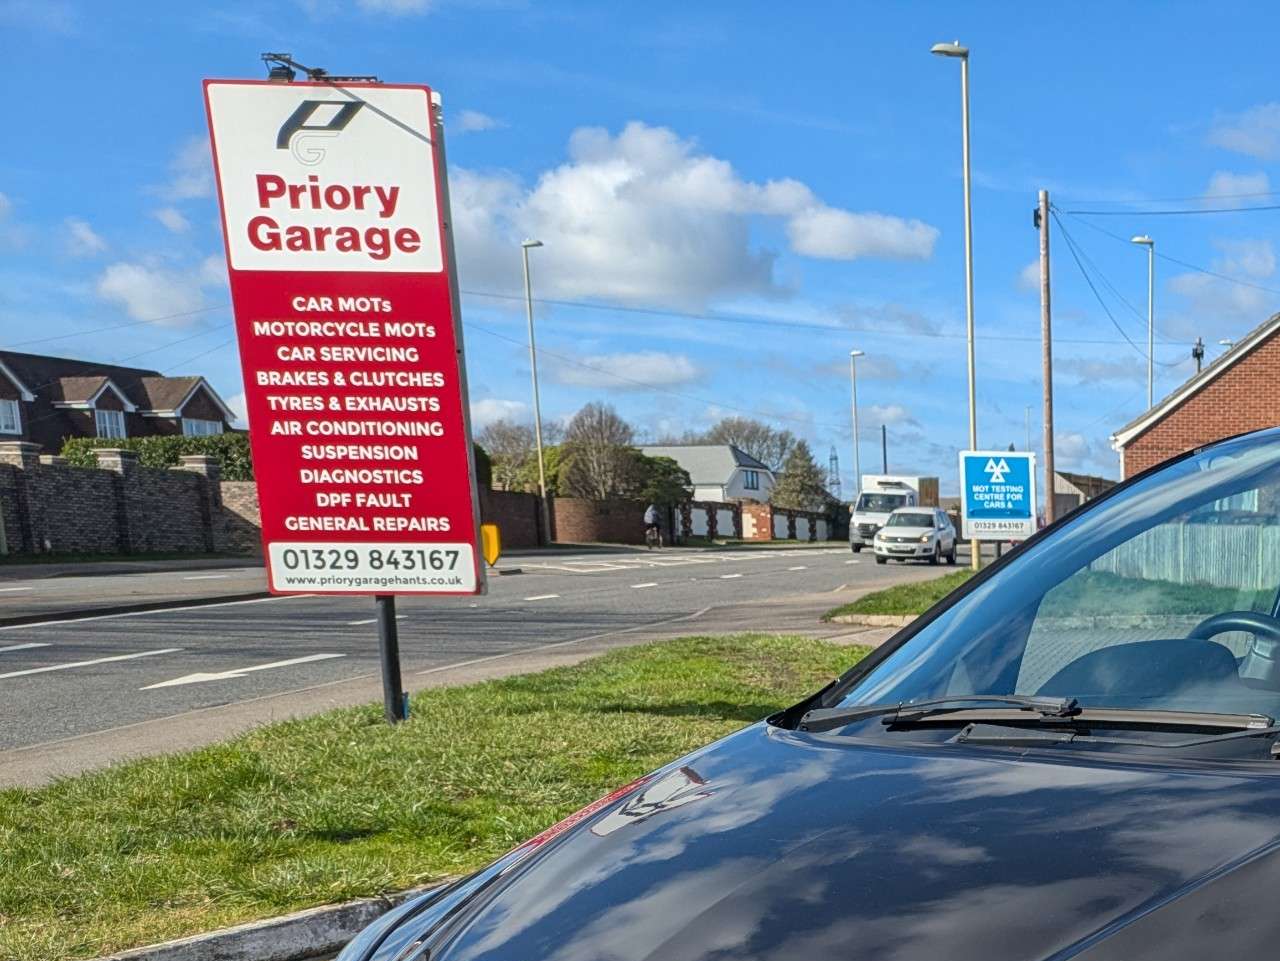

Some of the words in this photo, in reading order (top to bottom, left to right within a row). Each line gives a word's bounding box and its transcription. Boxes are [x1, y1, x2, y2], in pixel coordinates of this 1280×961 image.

[255, 174, 400, 218] Priory
[247, 215, 421, 261] Garage
[292, 296, 334, 312] CAR
[338, 297, 392, 313] MOTs
[254, 321, 381, 337] MOTORCYCLE
[384, 322, 436, 338] MOTs
[277, 346, 316, 361] CAR
[320, 346, 420, 363] SERVICING
[256, 371, 329, 386] BRAKES
[333, 372, 346, 387] &
[349, 371, 445, 388] CLUTCHES
[267, 396, 325, 411] TYRES
[328, 396, 341, 411] &
[345, 396, 441, 412] EXHAUSTS
[270, 421, 303, 436] AIR
[306, 421, 444, 437] CONDITIONING
[301, 445, 418, 461] SUSPENSION
[300, 469, 424, 484] DIAGNOSTICS
[991, 485, 1024, 493] TESTING
[316, 493, 352, 508] DPF
[355, 493, 412, 508] FAULT
[285, 516, 370, 531] GENERAL
[373, 517, 450, 532] REPAIRS
[283, 549, 360, 570] 01329
[369, 550, 460, 571] 843167
[286, 575, 463, 587] www.priorygaragehants.co.uk
